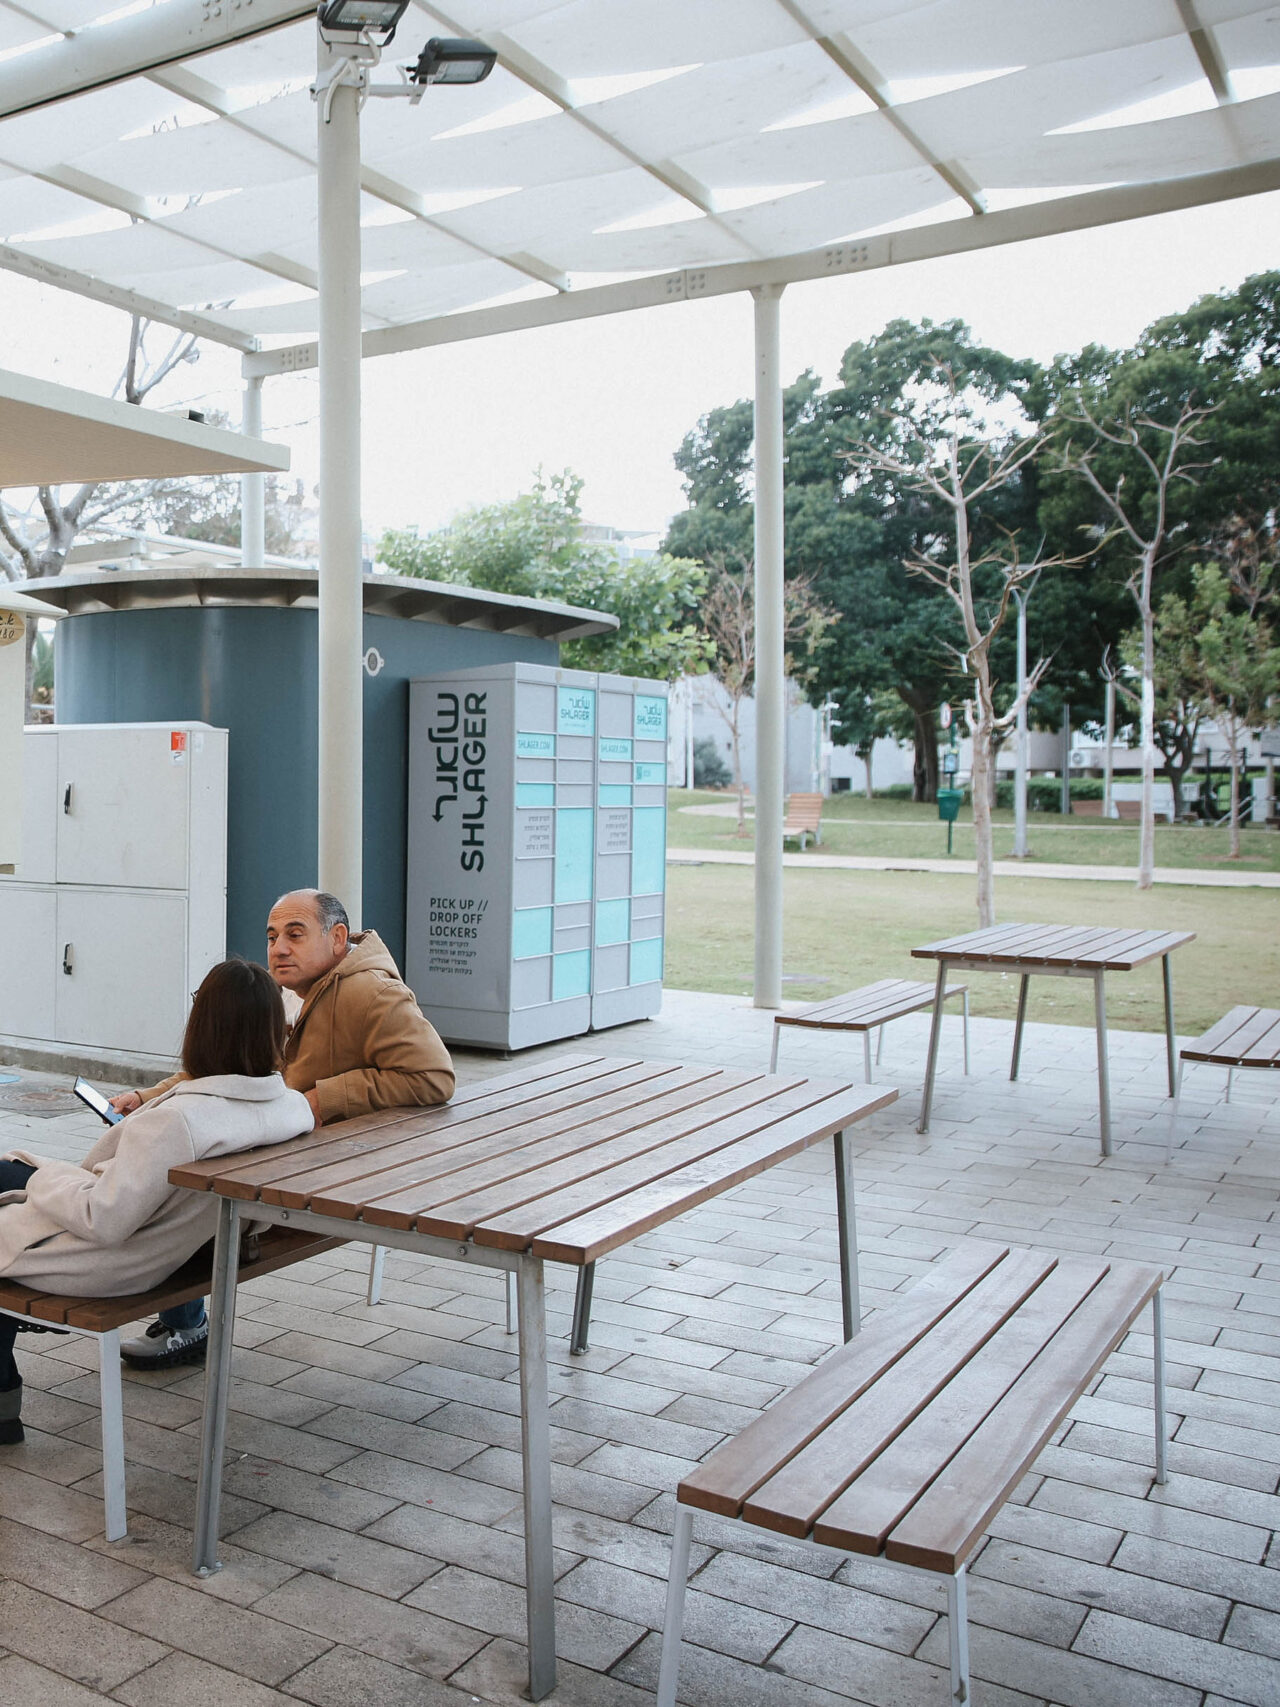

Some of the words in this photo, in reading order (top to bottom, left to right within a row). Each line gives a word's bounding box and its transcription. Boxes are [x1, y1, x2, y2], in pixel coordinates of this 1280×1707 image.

[560, 708, 590, 720] SHLAGER
[460, 692, 488, 872] SHLAGER
[430, 897, 456, 909] PICK
[459, 899, 474, 910] UP
[430, 911, 459, 923] DROP
[462, 913, 483, 925] OFF
[430, 925, 478, 939] LOCKERS
